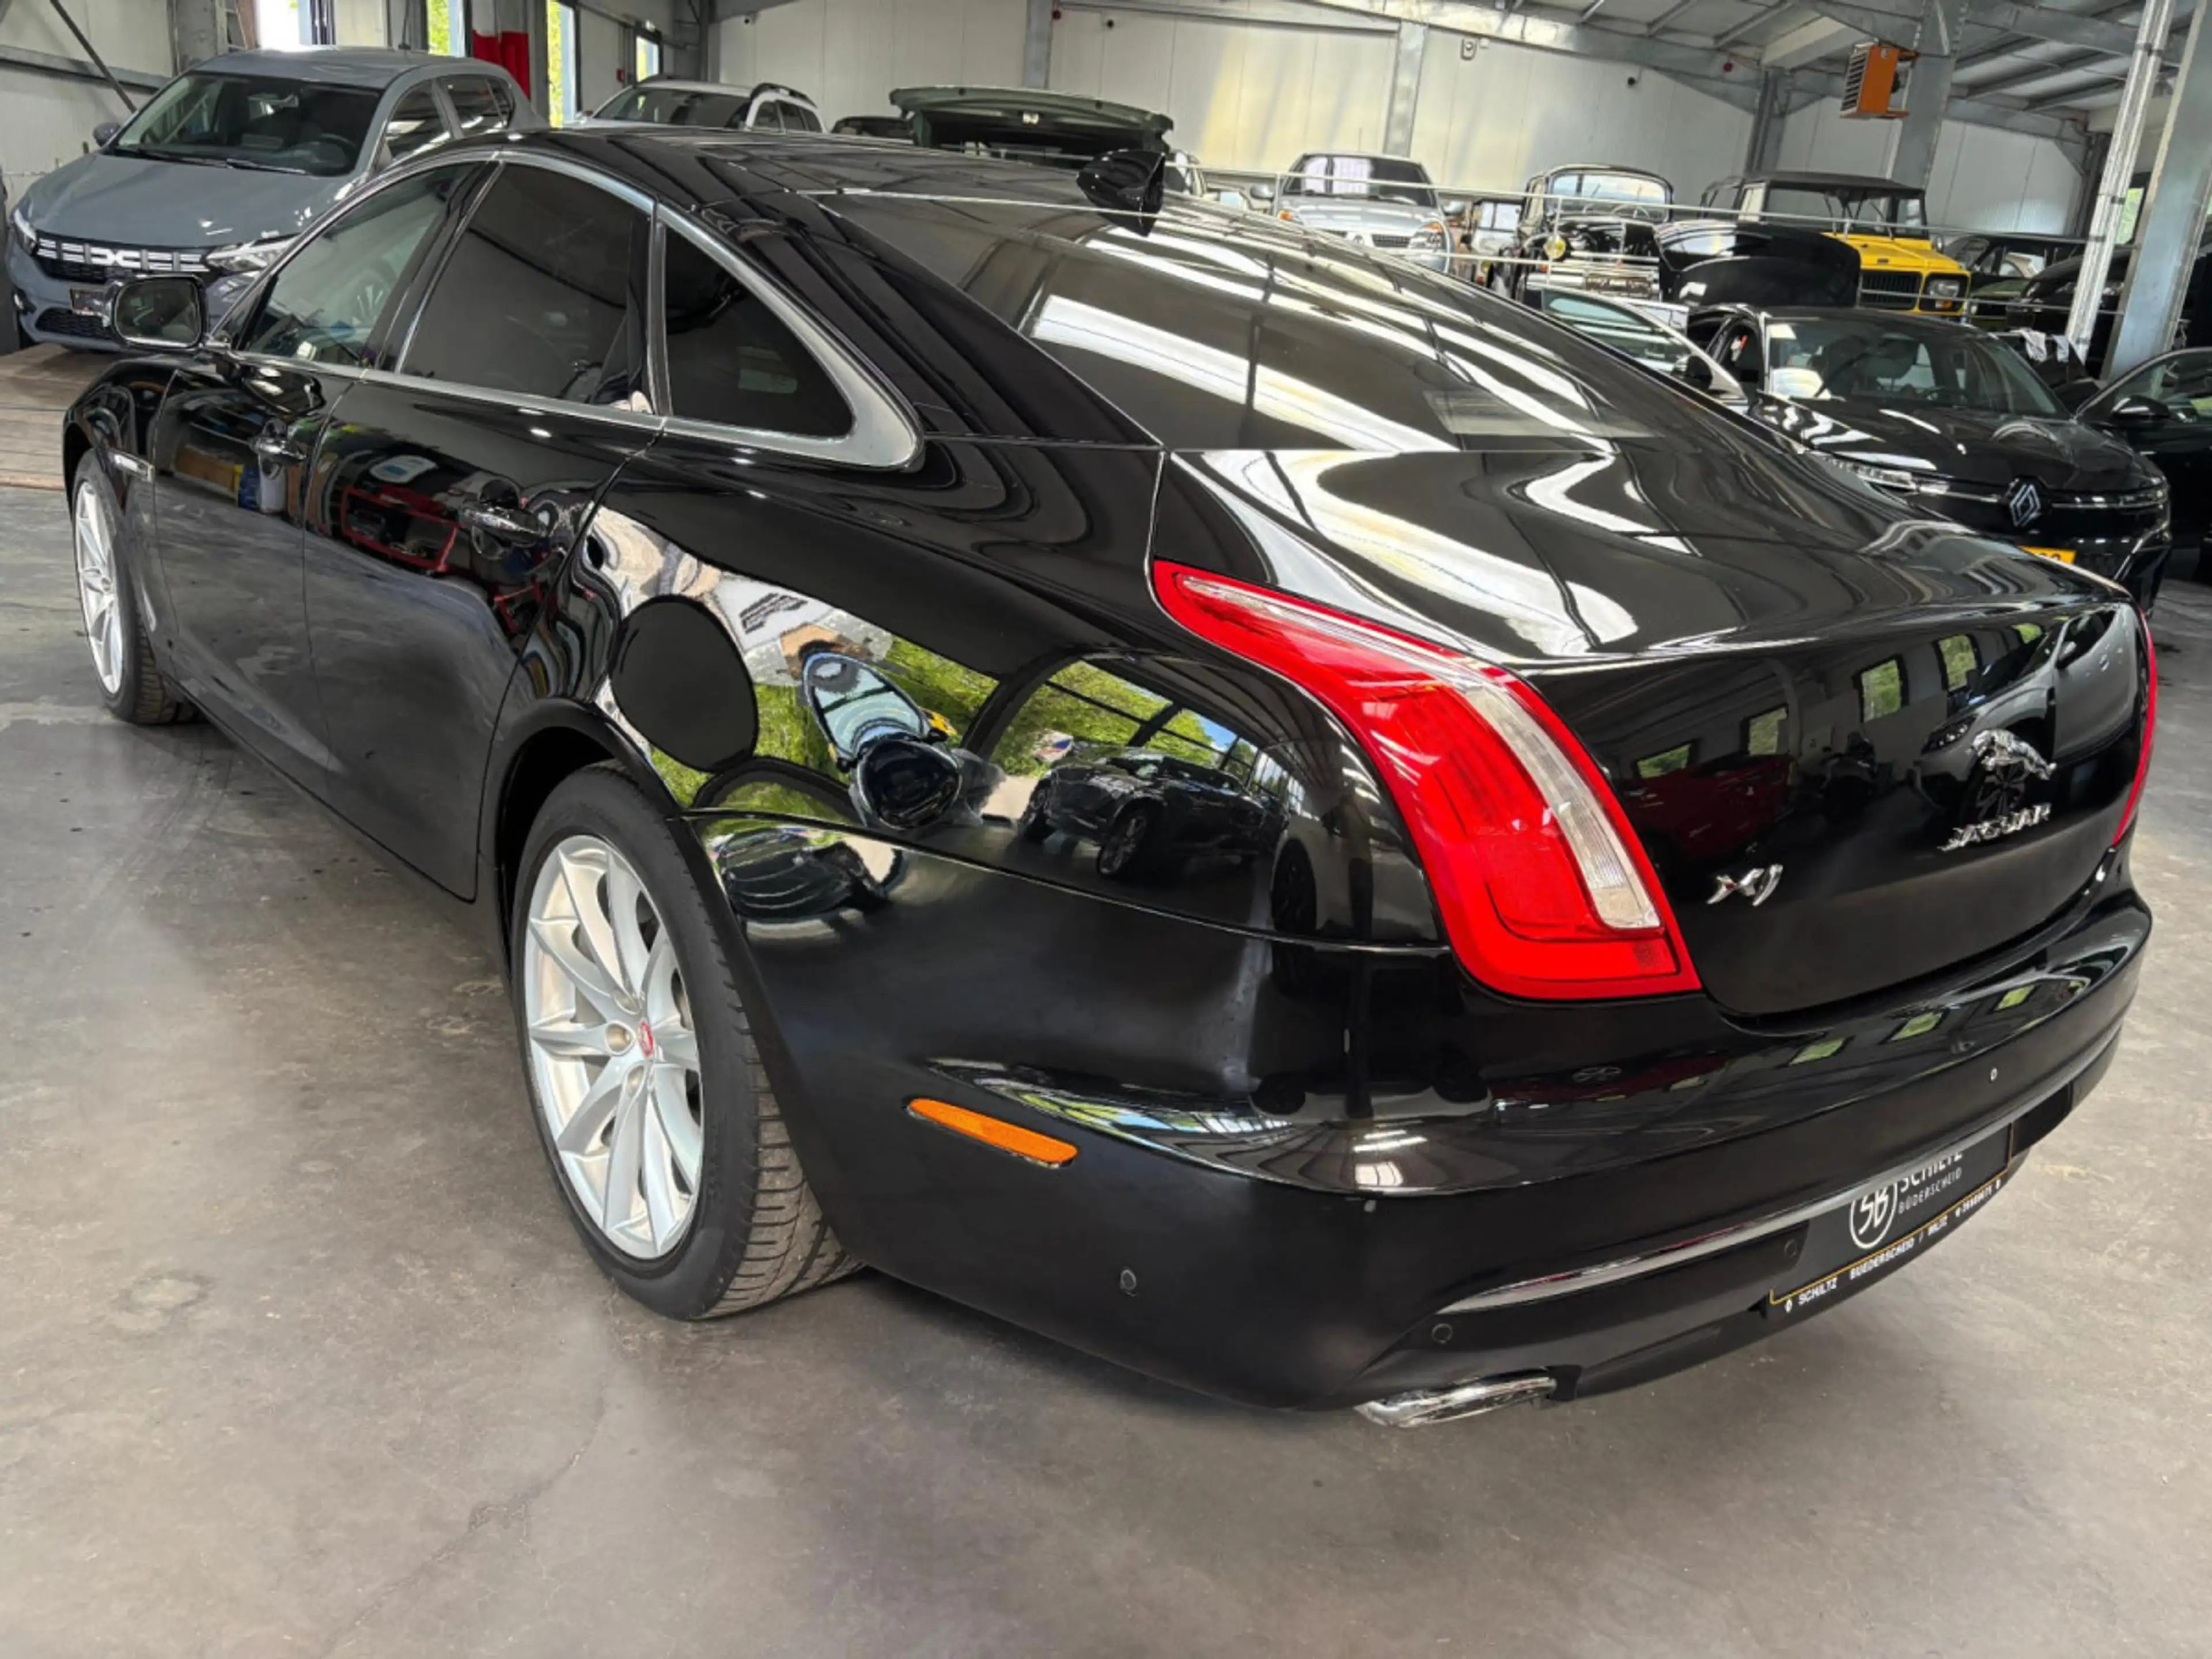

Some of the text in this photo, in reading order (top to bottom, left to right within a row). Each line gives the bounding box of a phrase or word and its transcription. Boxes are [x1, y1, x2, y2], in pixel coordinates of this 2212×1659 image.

[1936, 802, 2052, 853] JAGUAR
[1706, 863, 1783, 907] XJ
[1798, 1277, 1838, 1306] SCHILTZ
